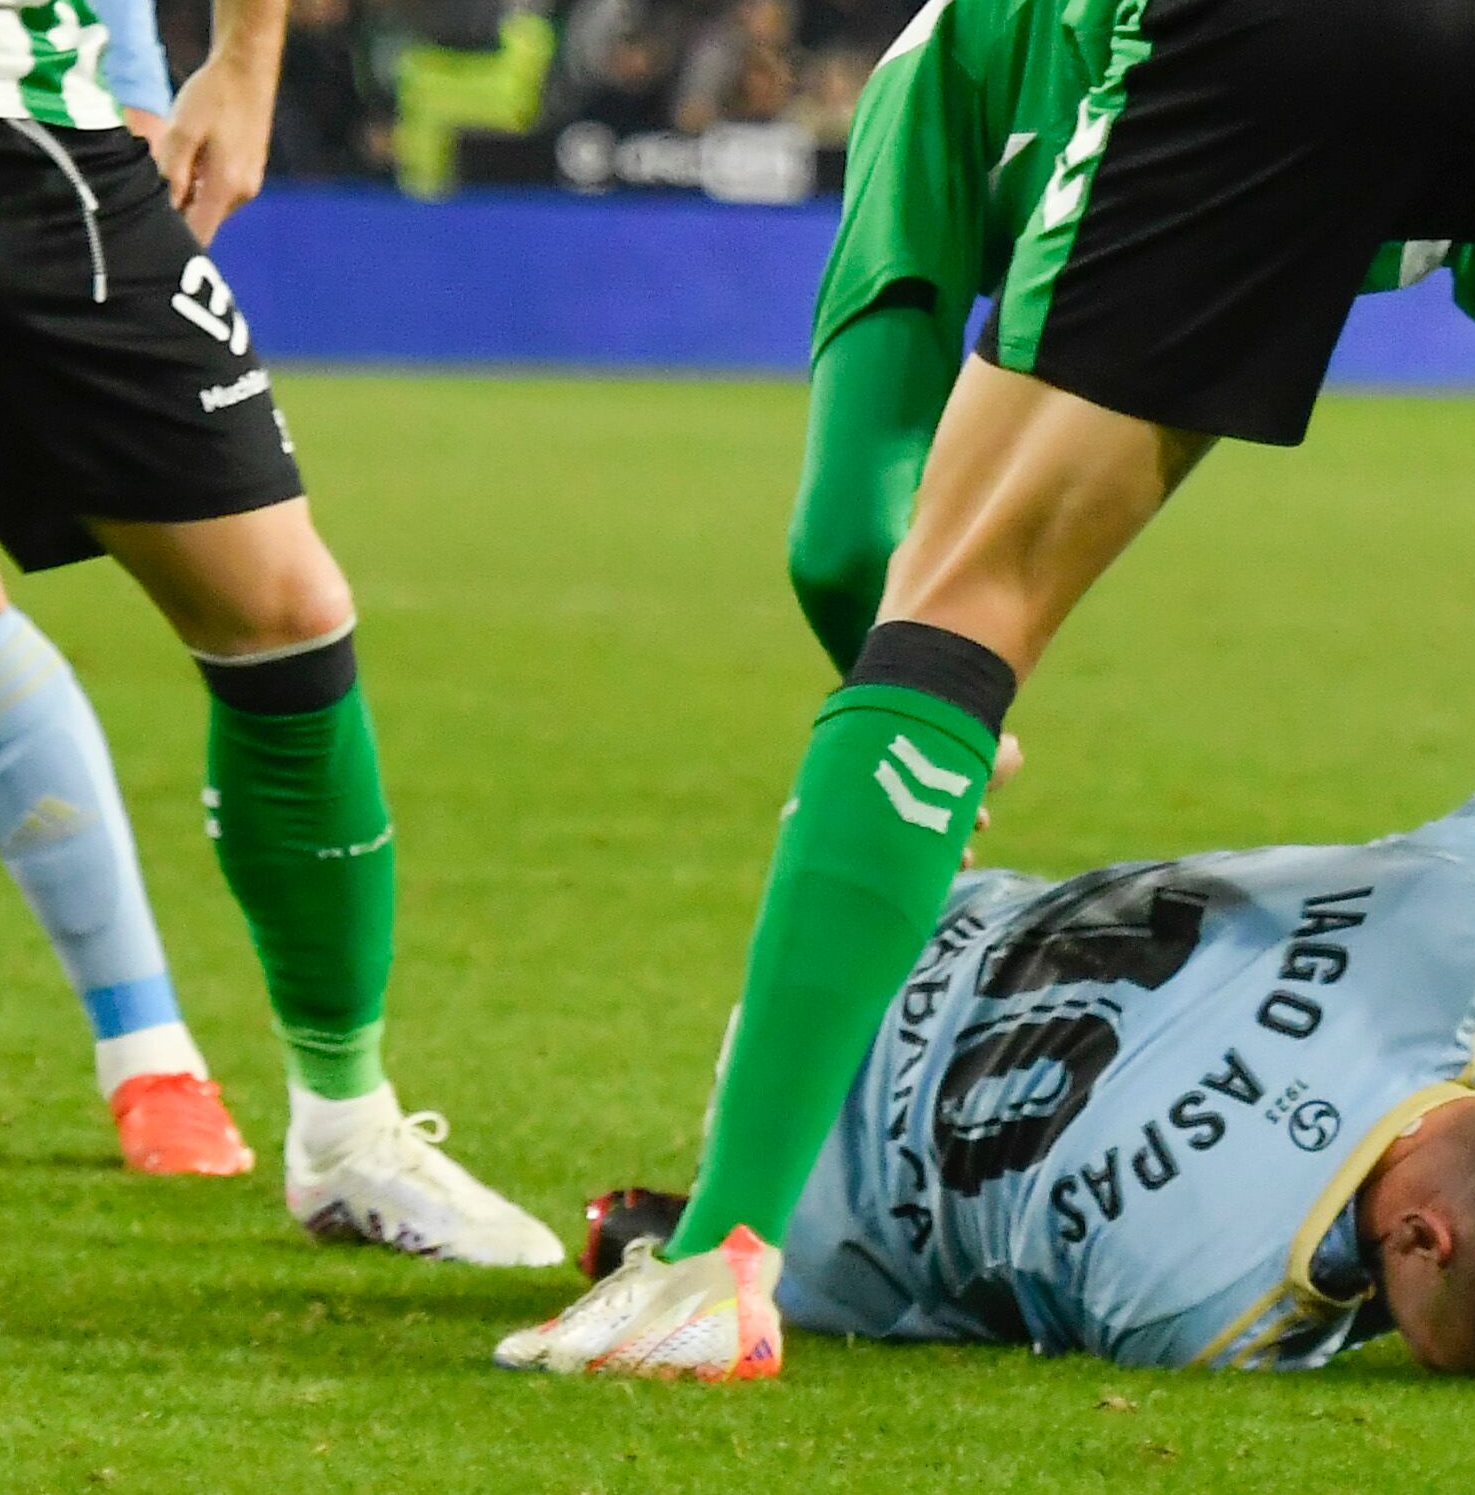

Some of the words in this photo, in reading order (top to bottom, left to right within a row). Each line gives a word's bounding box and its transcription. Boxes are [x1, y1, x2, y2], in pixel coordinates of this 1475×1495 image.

[932, 864, 1210, 1197] 10
[1257, 885, 1375, 1040] IAGO
[1049, 1047, 1266, 1244] ASPAS
[1264, 1078, 1310, 1126] 1923
